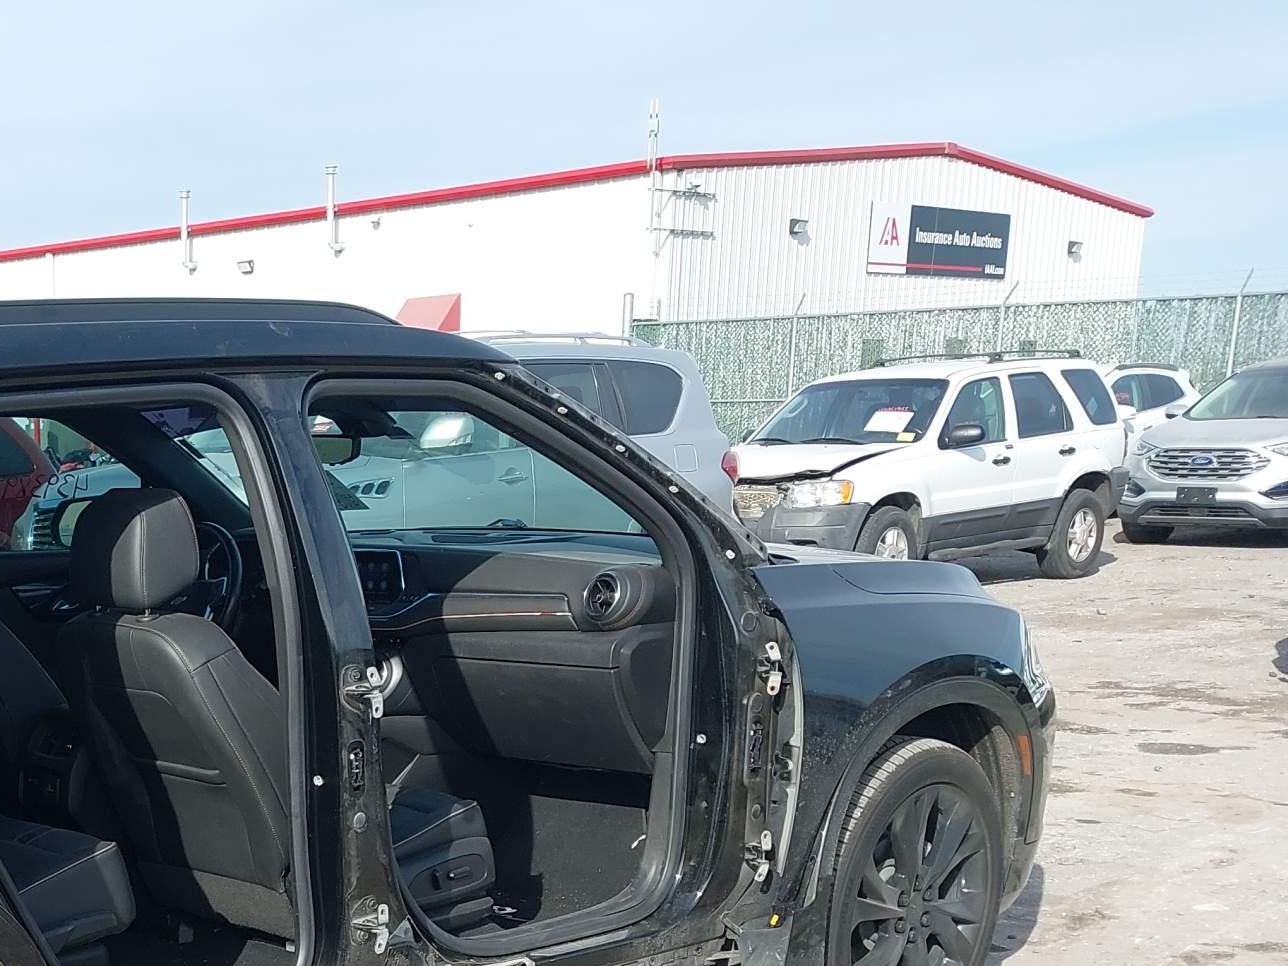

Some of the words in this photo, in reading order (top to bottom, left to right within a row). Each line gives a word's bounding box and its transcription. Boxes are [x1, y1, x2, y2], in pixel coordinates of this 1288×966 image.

[915, 226, 953, 245] Insurance
[953, 229, 971, 246] Auto
[971, 231, 1002, 249] Auctions
